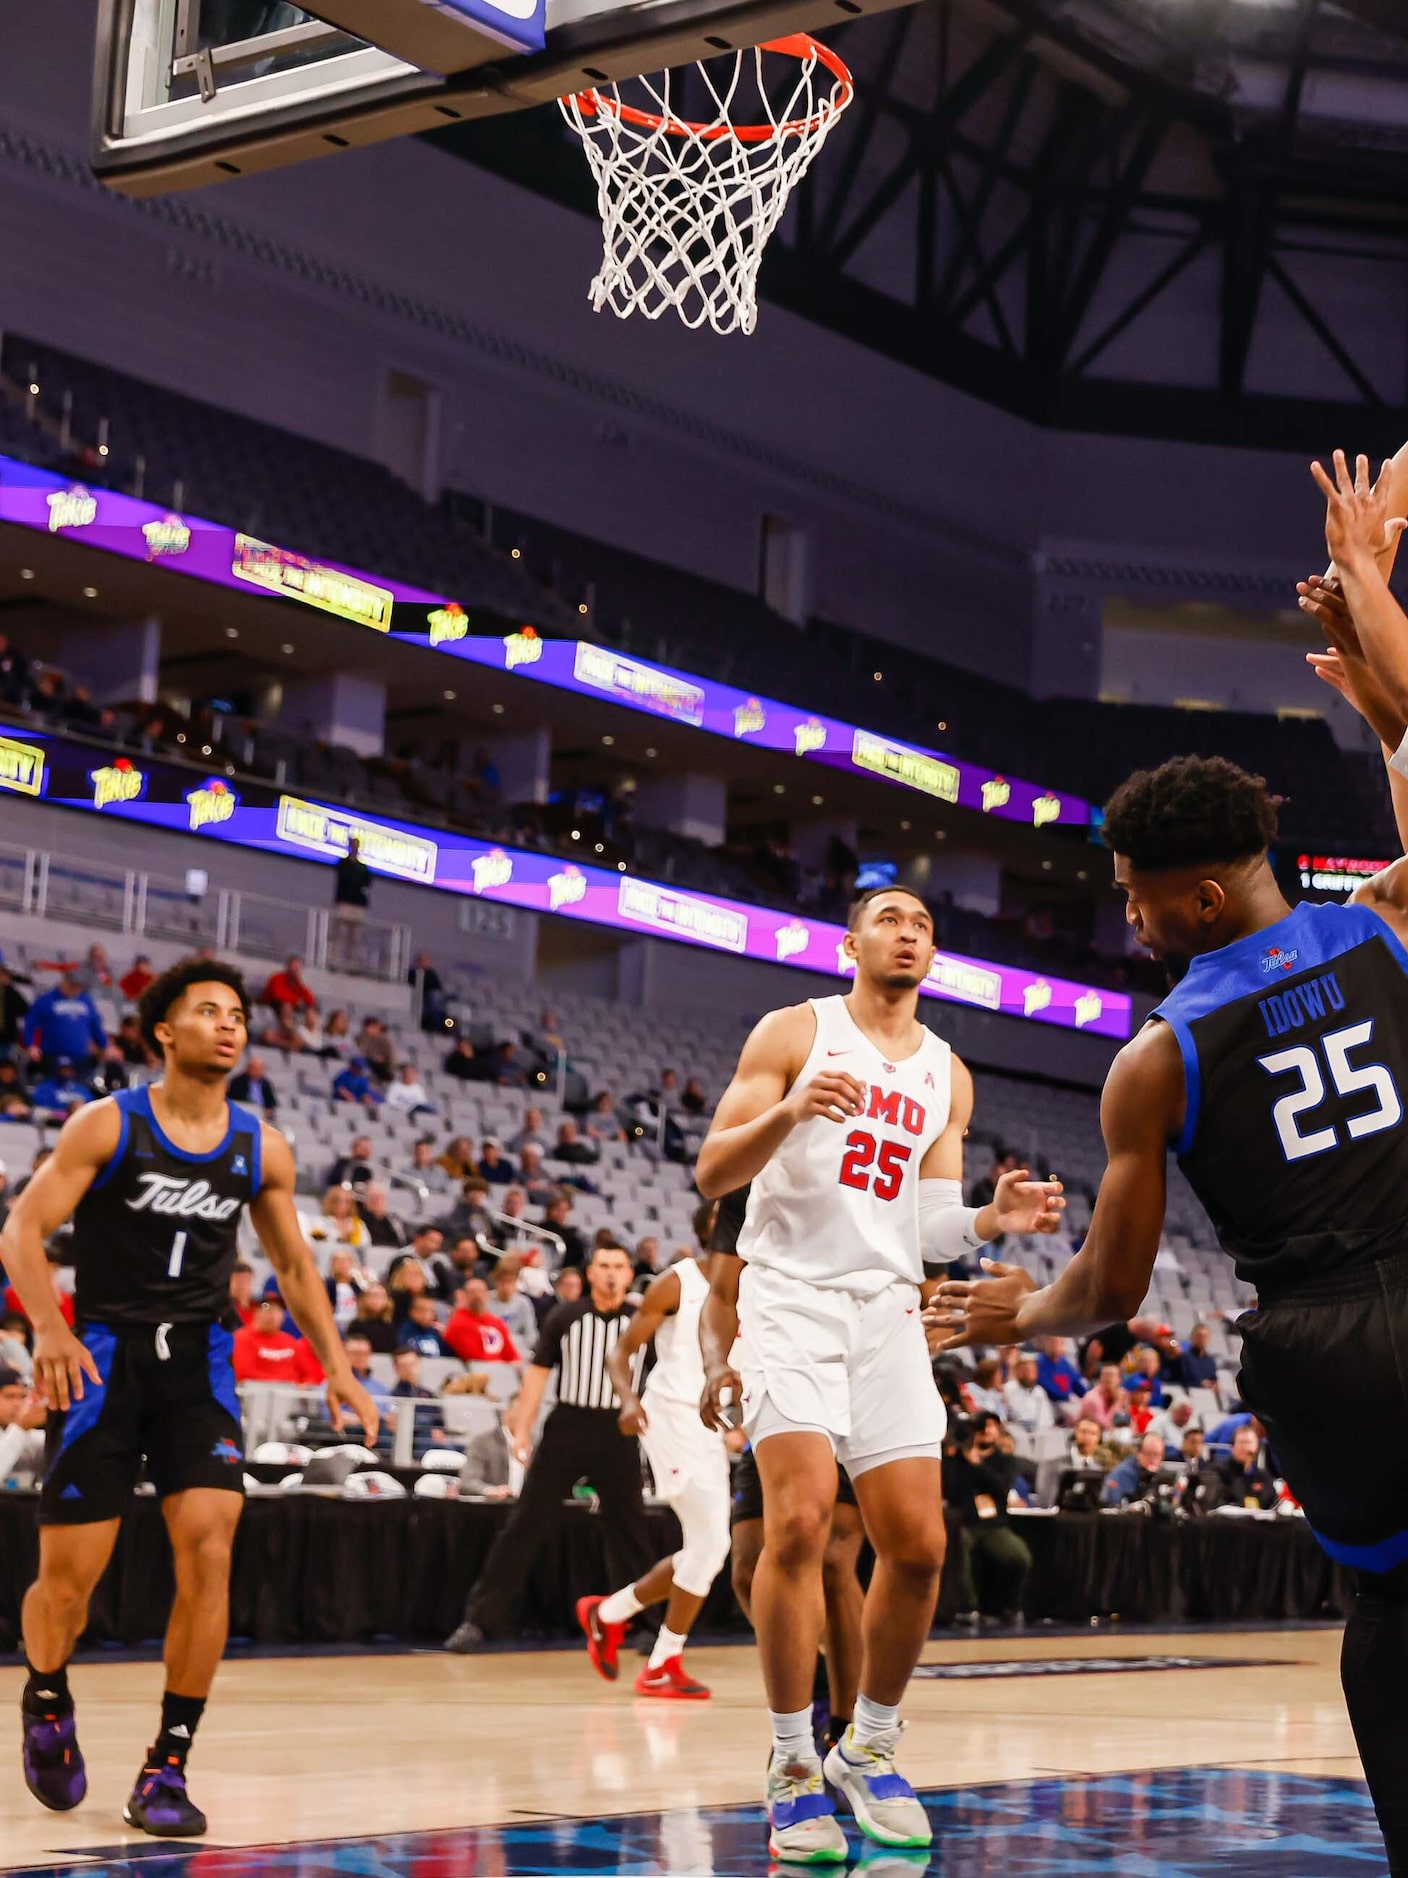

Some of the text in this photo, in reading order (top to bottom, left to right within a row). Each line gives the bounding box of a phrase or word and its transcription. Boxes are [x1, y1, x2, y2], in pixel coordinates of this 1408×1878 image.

[1262, 950, 1298, 973] Tulsa
[1258, 972, 1345, 1038] IDOWU
[1256, 1018, 1404, 1163] 25
[839, 1130, 912, 1201] 25
[124, 1172, 241, 1221] Tulsa
[167, 1230, 187, 1278] 1
